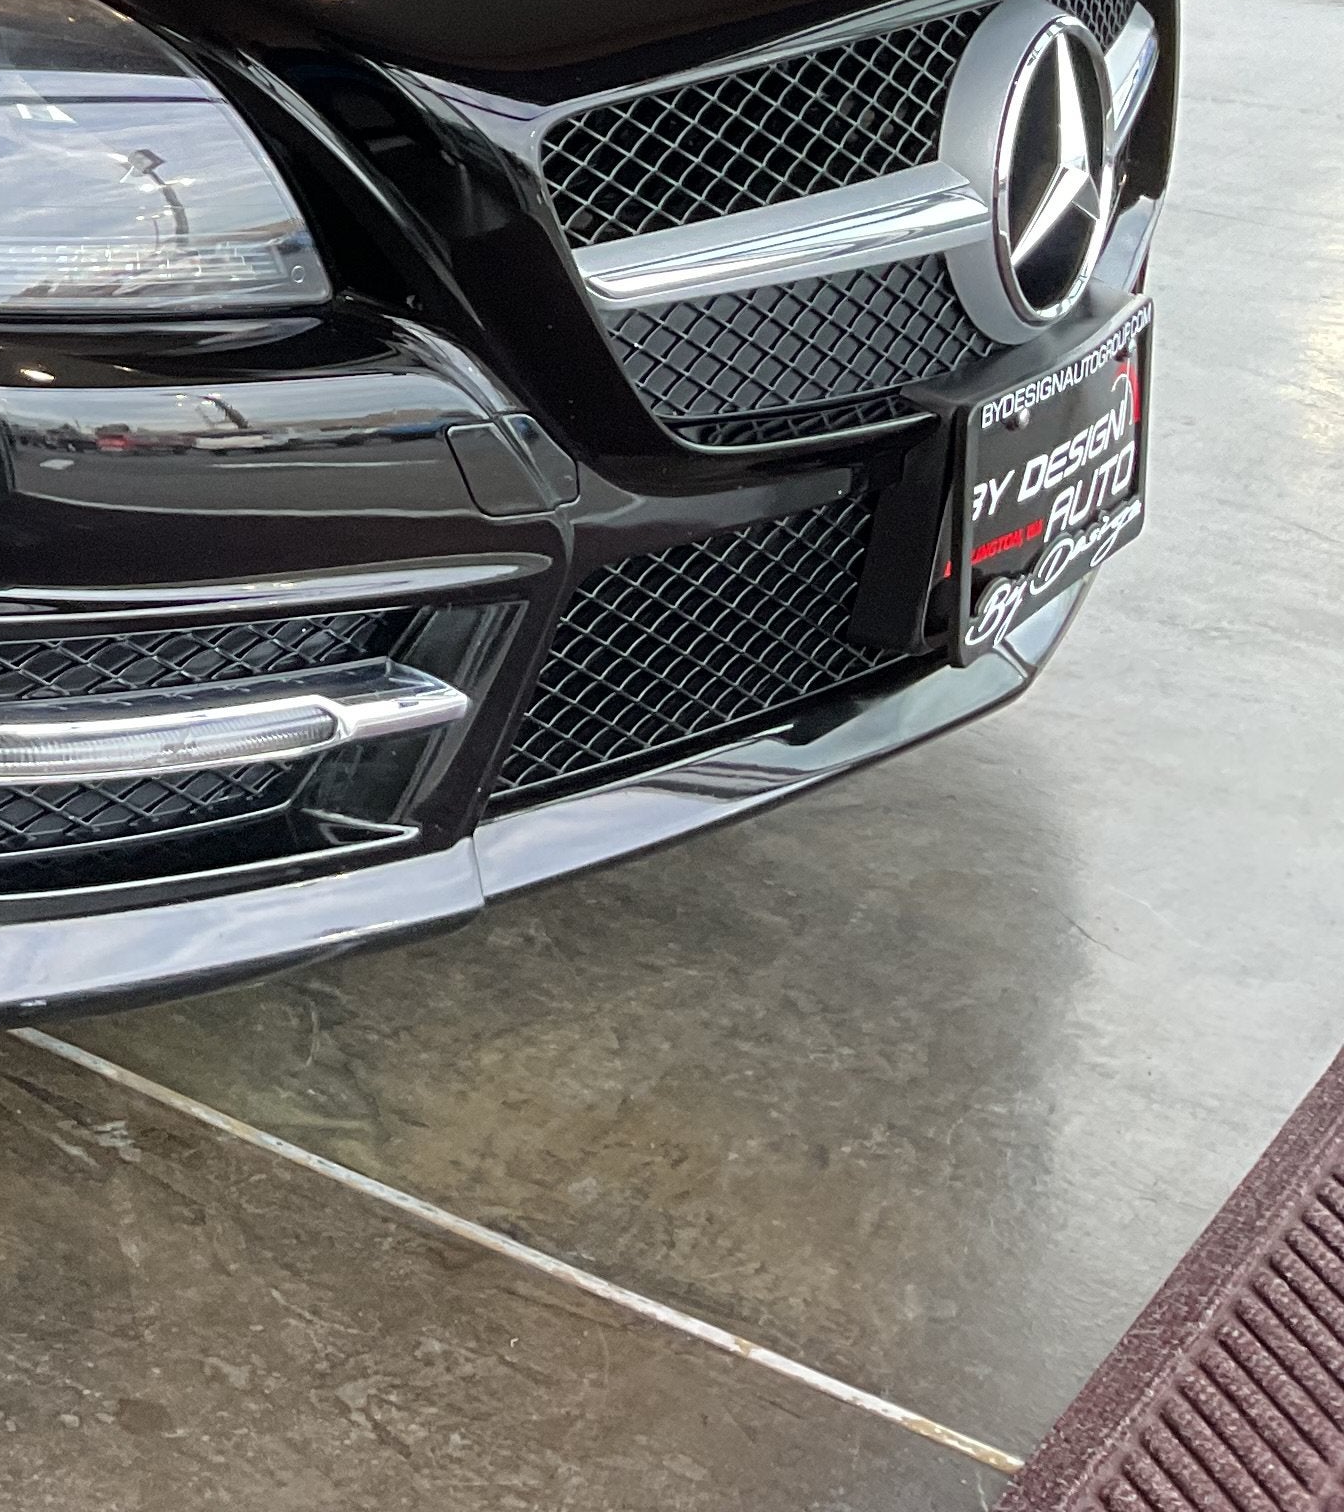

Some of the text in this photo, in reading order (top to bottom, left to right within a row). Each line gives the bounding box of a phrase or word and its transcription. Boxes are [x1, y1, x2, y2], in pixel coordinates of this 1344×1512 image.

[1017, 399, 1126, 503] DESIGN
[1044, 440, 1136, 543] AUTO
[965, 499, 1141, 647] By Design
